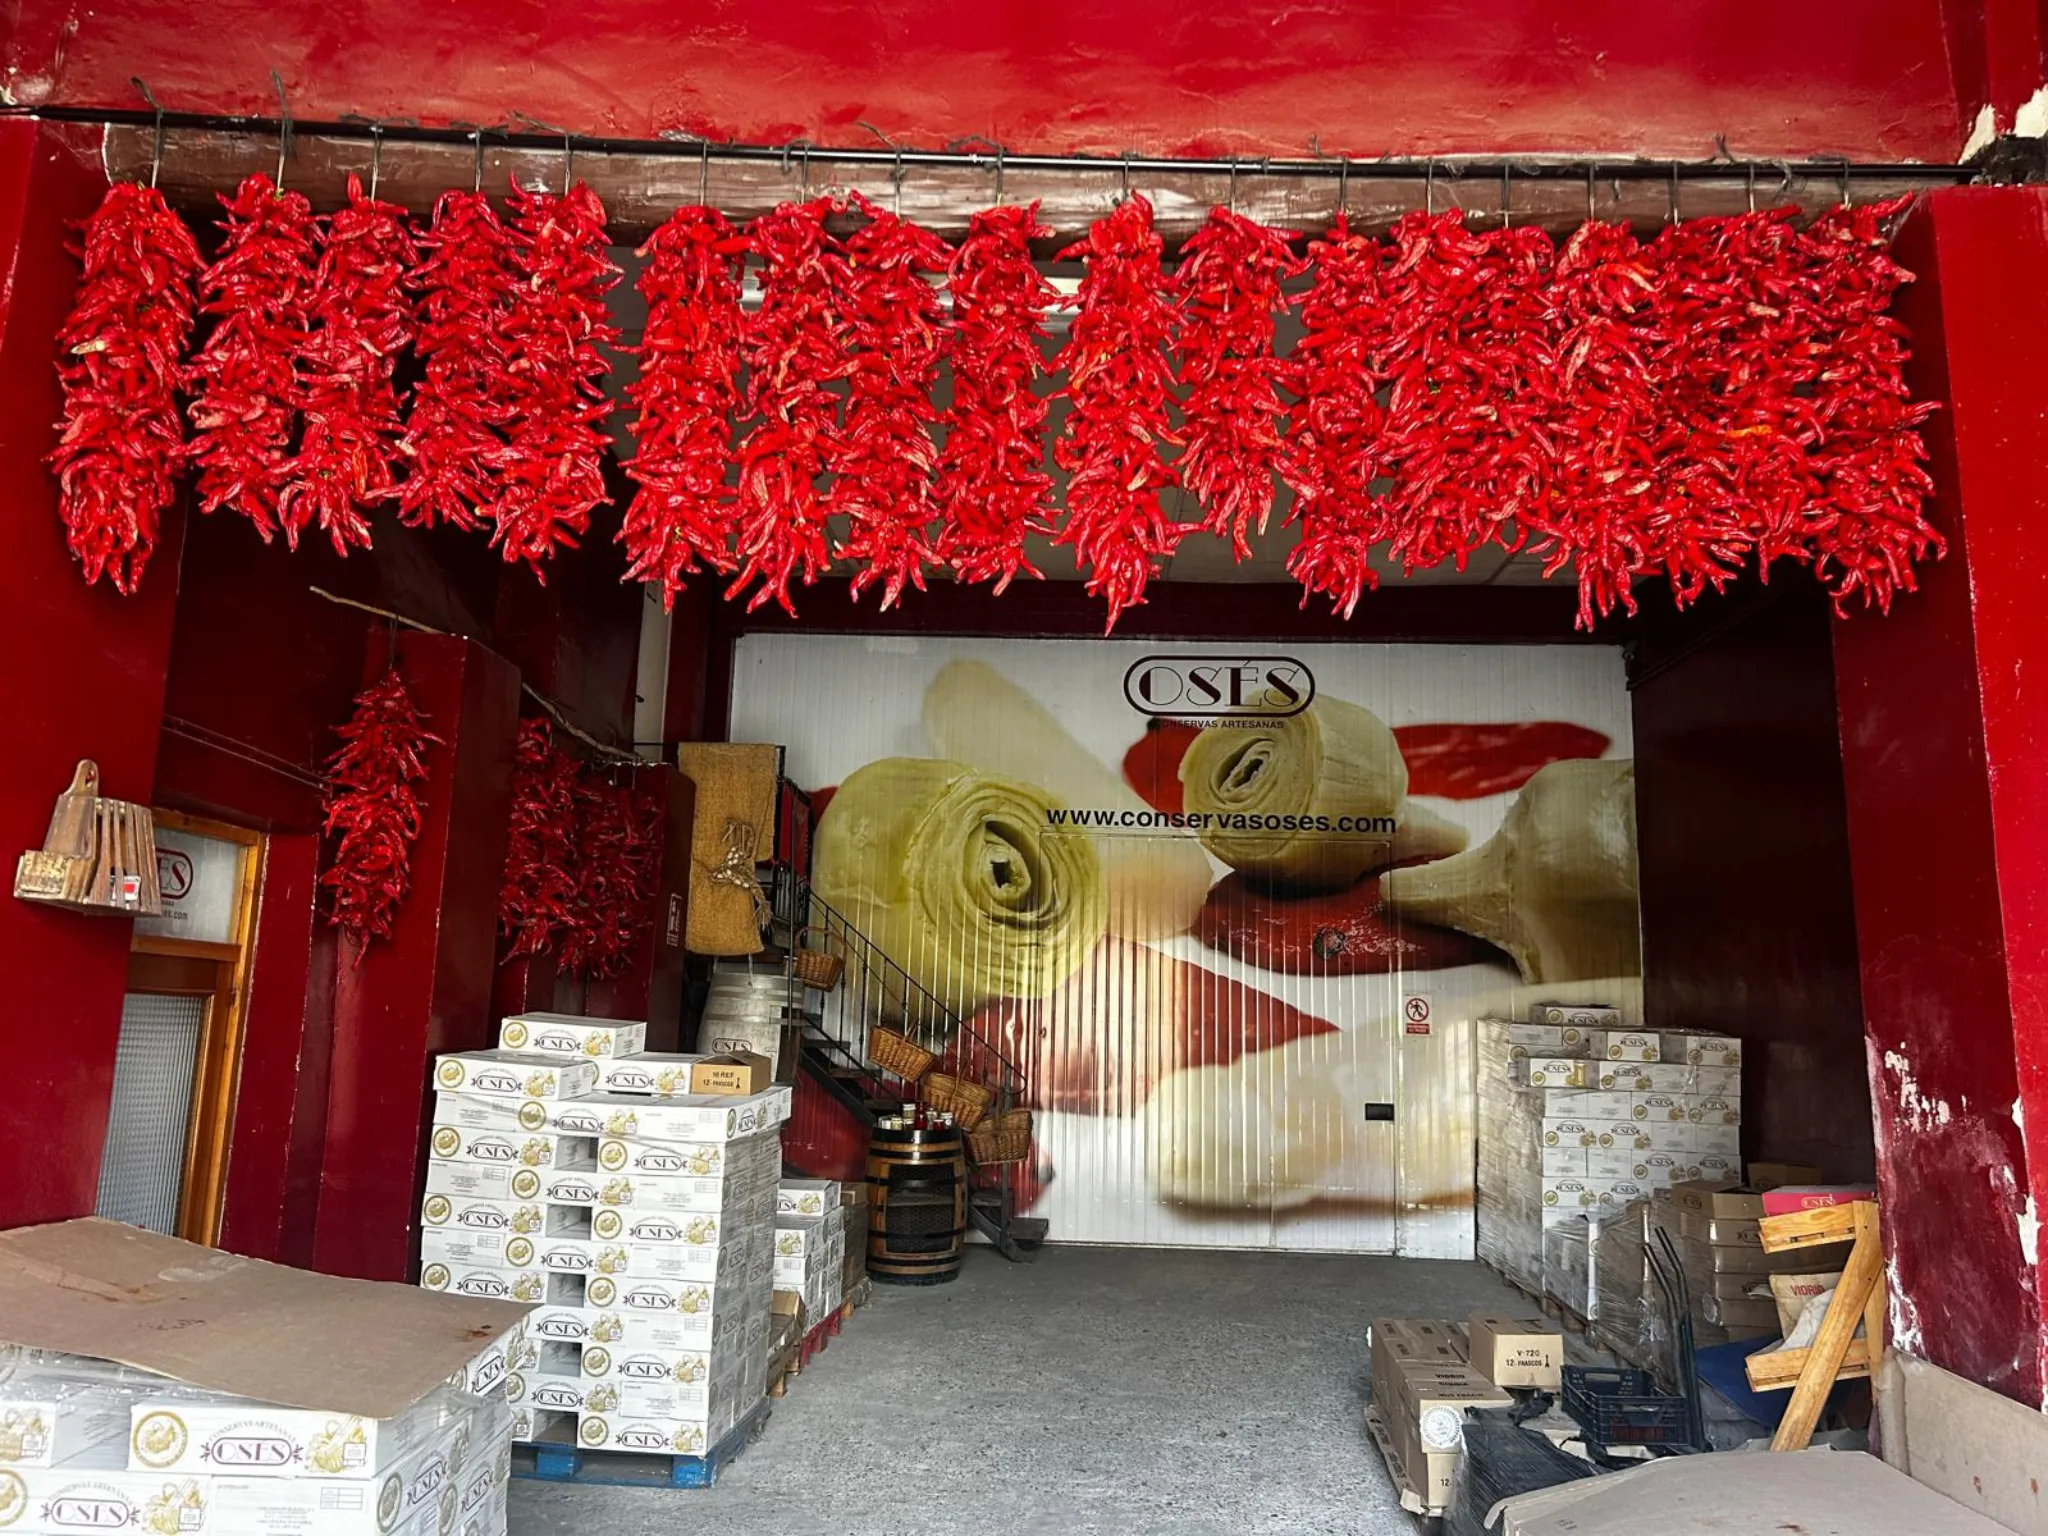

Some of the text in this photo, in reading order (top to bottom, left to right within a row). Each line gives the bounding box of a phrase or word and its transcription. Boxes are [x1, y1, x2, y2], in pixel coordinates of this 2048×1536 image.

[1155, 719, 1284, 729] ONSERVAS ARTESANAS
[1046, 809, 1396, 833] www.conservasoses.com
